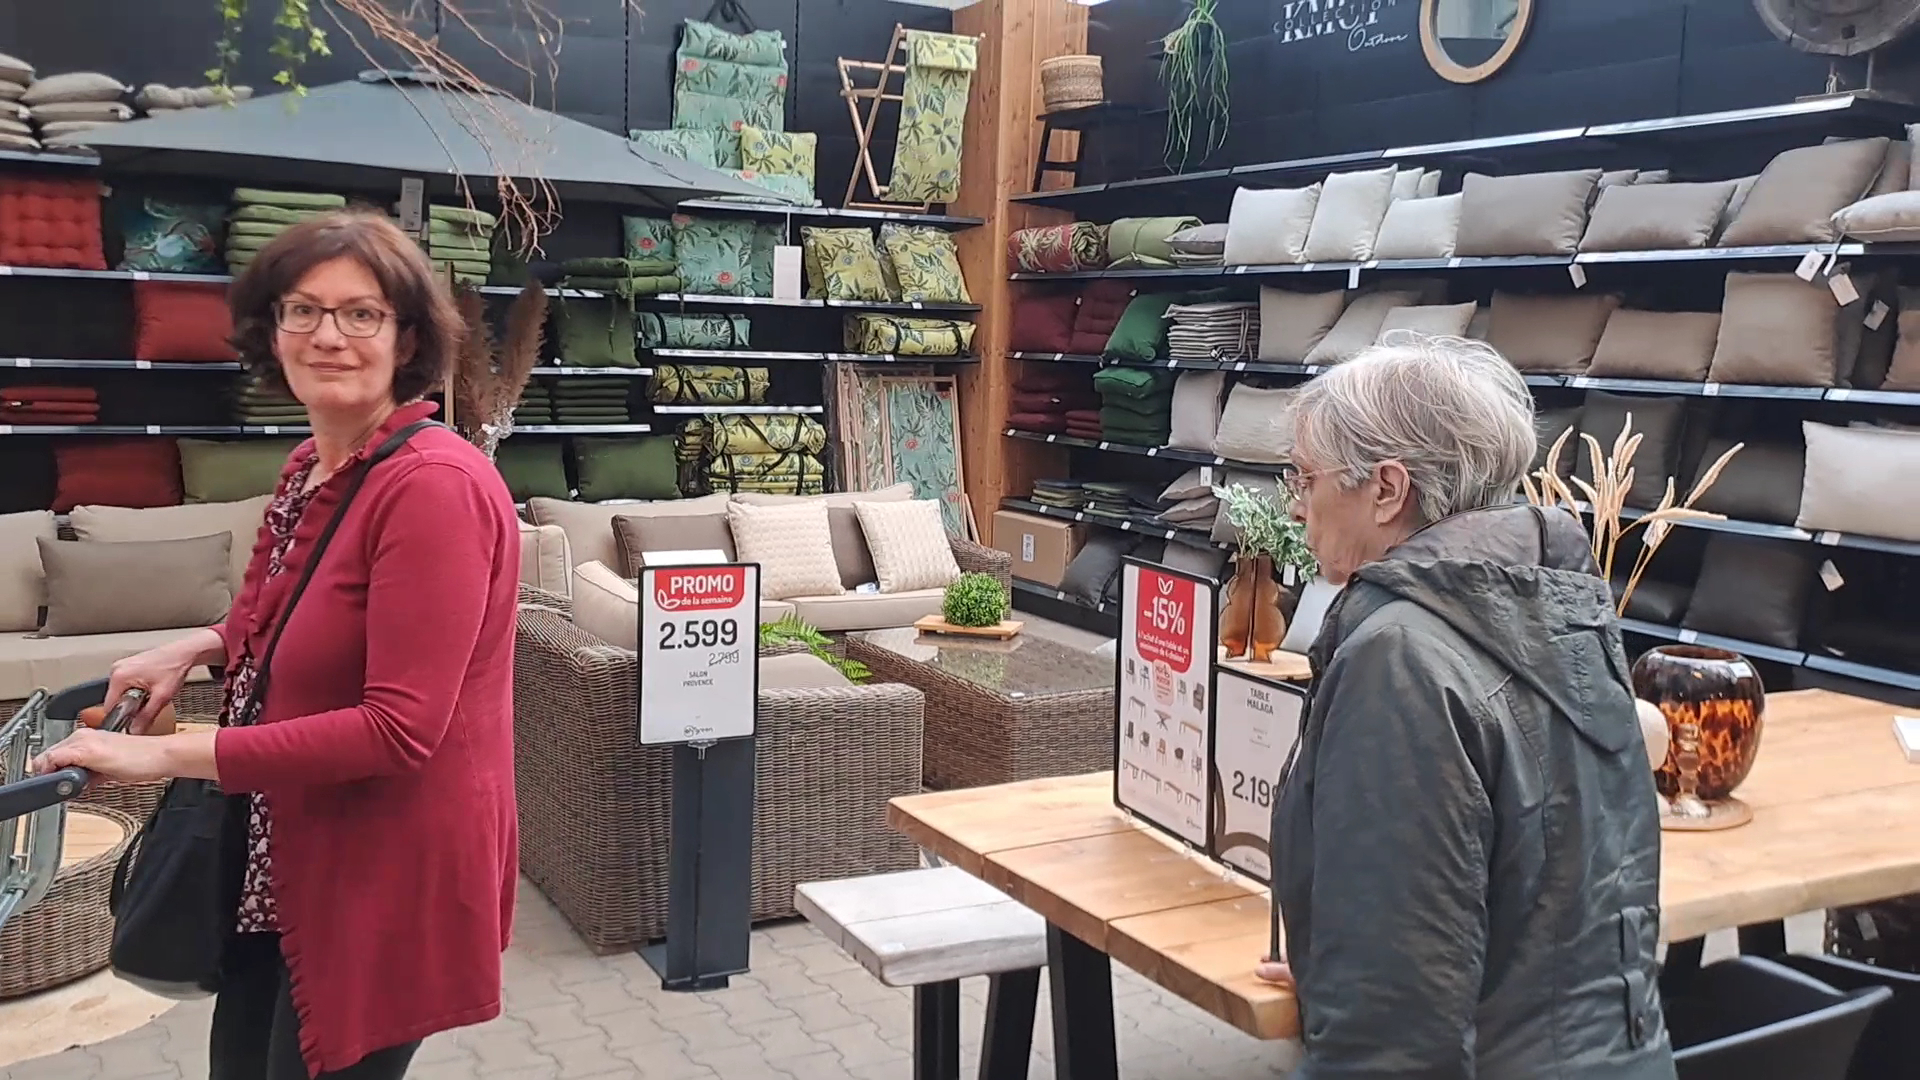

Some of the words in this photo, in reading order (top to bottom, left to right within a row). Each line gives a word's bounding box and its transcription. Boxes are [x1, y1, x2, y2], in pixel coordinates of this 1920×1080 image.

[670, 574, 734, 595] PROMO
[681, 597, 691, 606] de
[693, 596, 699, 605] la
[701, 595, 734, 604] semaine
[1143, 596, 1186, 636] -15%
[659, 618, 738, 650] 2.599
[683, 679, 713, 687] PROVENCE
[1250, 687, 1270, 702] TABLE
[1246, 698, 1274, 715] MALAGA
